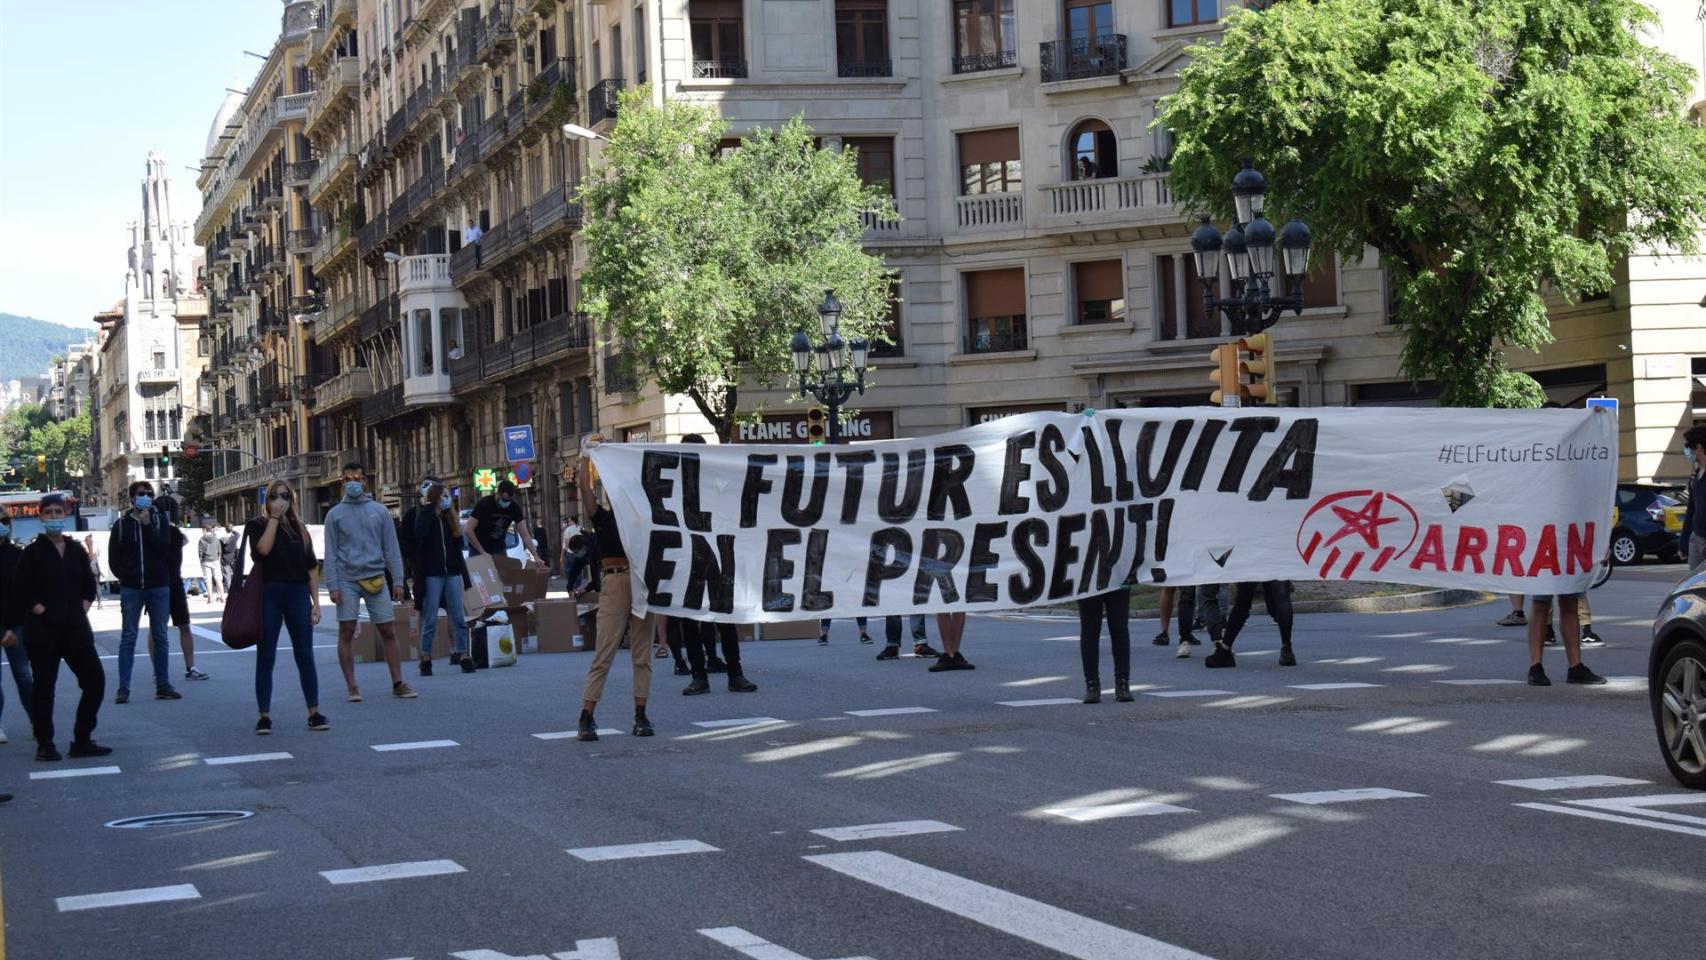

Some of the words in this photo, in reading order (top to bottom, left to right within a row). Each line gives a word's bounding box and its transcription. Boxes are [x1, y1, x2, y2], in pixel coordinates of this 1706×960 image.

[740, 421, 792, 440] FLAME
[1438, 442, 1610, 465] #ElFuturEsLluita
[641, 450, 712, 532] EL
[739, 444, 976, 528] FUTUR
[998, 423, 1070, 515] ES
[1081, 416, 1319, 504] LLUITA
[643, 530, 736, 614] EN
[762, 528, 834, 612] EL
[862, 498, 1175, 608] PRESENT!
[1409, 521, 1596, 577] ARRAN
